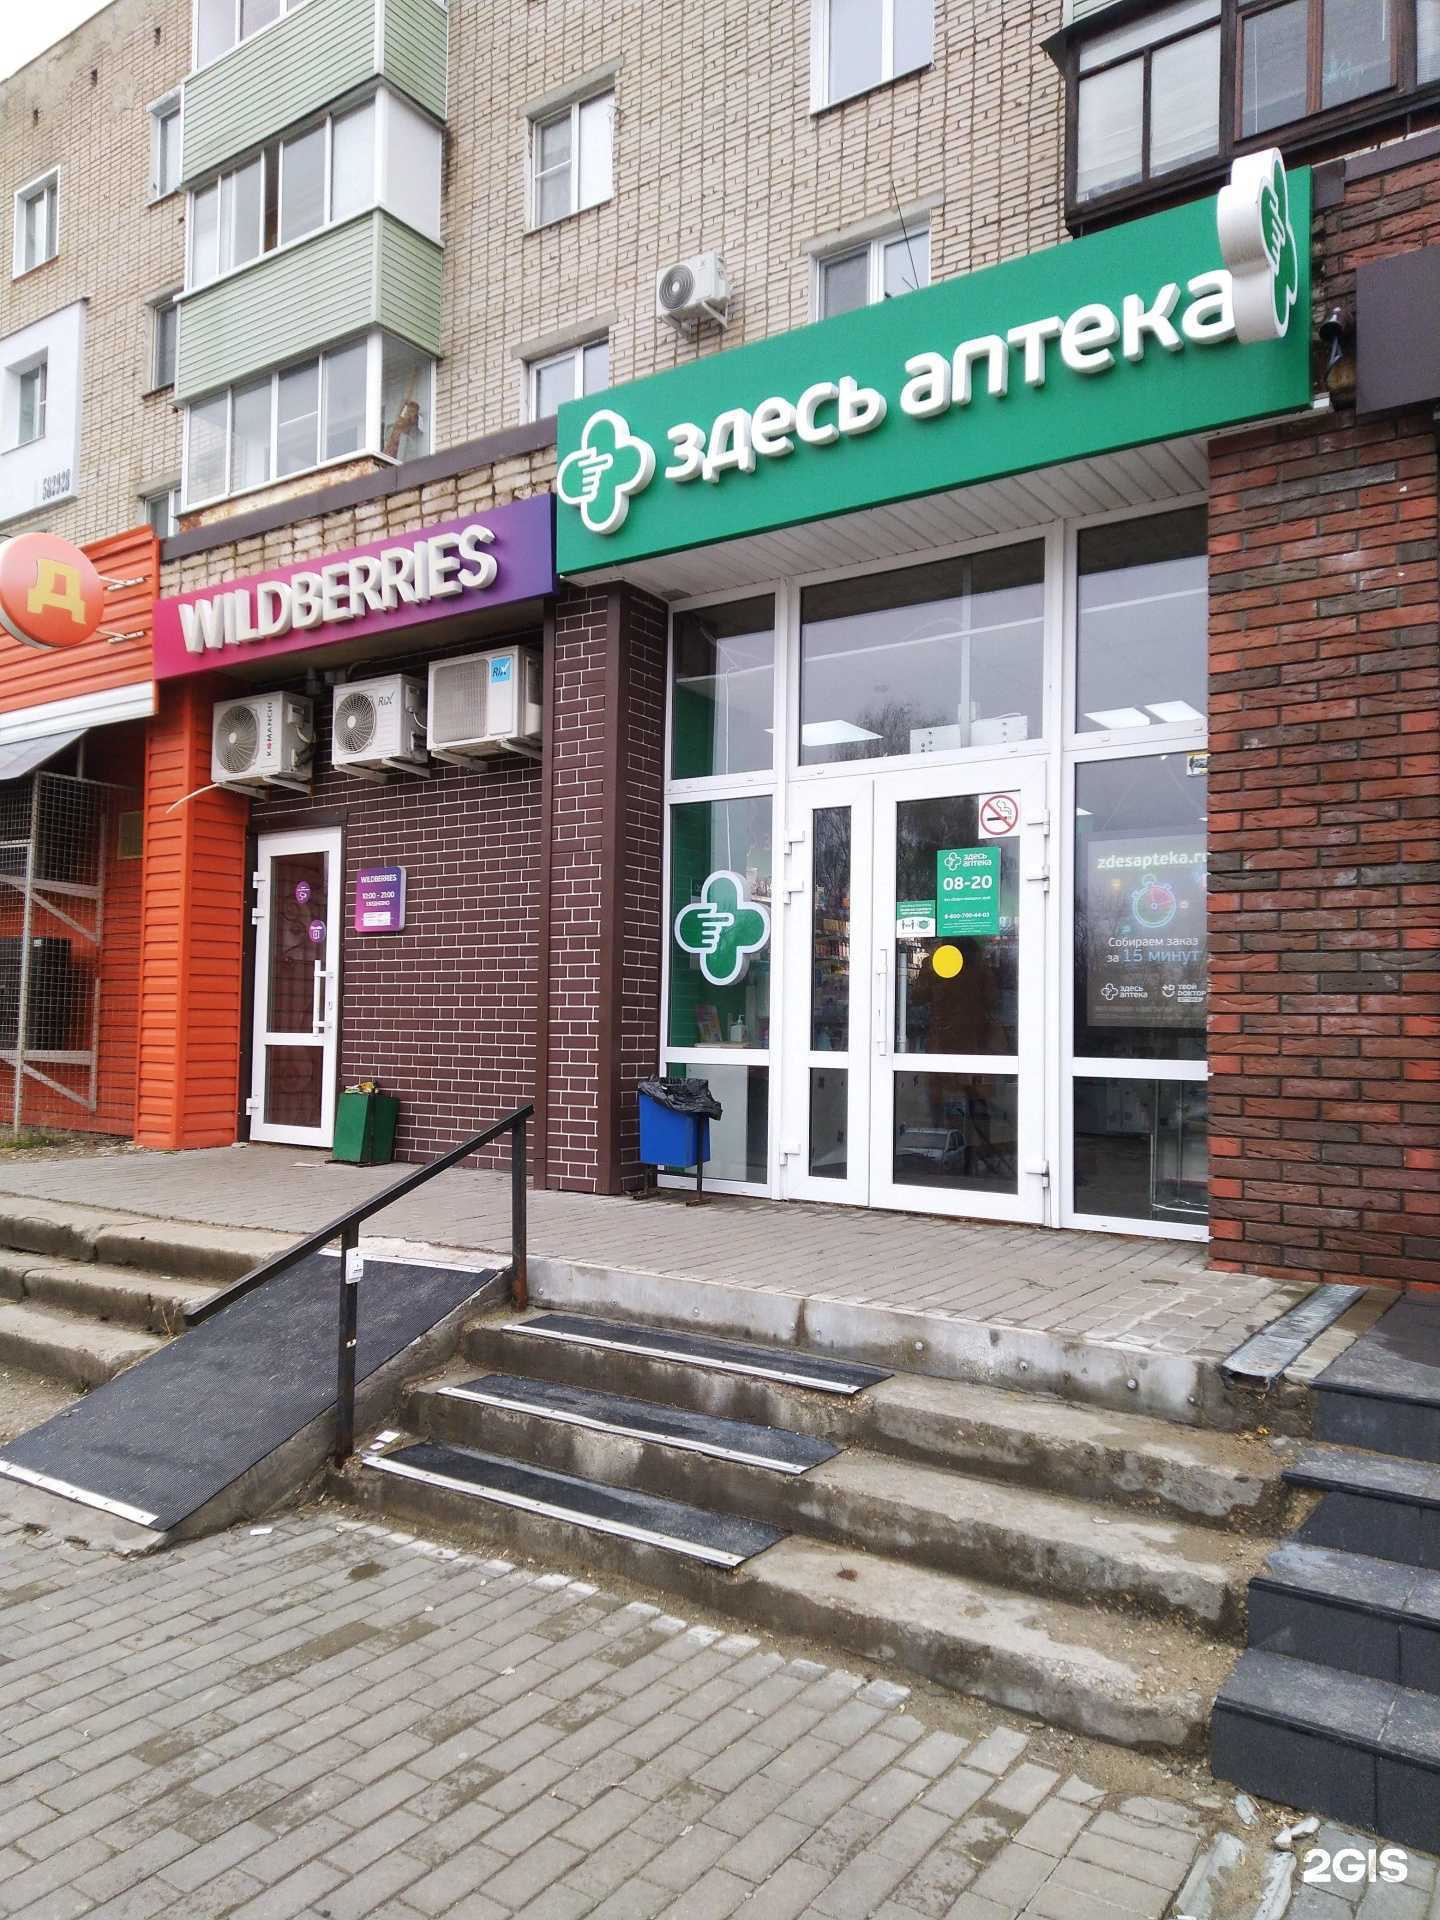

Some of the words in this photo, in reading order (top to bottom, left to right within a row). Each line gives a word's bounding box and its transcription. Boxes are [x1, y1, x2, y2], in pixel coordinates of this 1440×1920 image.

[665, 376, 887, 483] здесь
[900, 268, 1238, 419] аптека
[27, 559, 86, 625] Д
[178, 524, 498, 654] WILDBERRIES
[360, 874, 397, 883] WILDBERRIES
[943, 875, 992, 890] 08-20
[1108, 937, 1163, 948] Собираем
[1167, 938, 1199, 946] заказ
[1107, 954, 1119, 963] за
[1123, 949, 1143, 962] 15
[1148, 950, 1201, 965] минут
